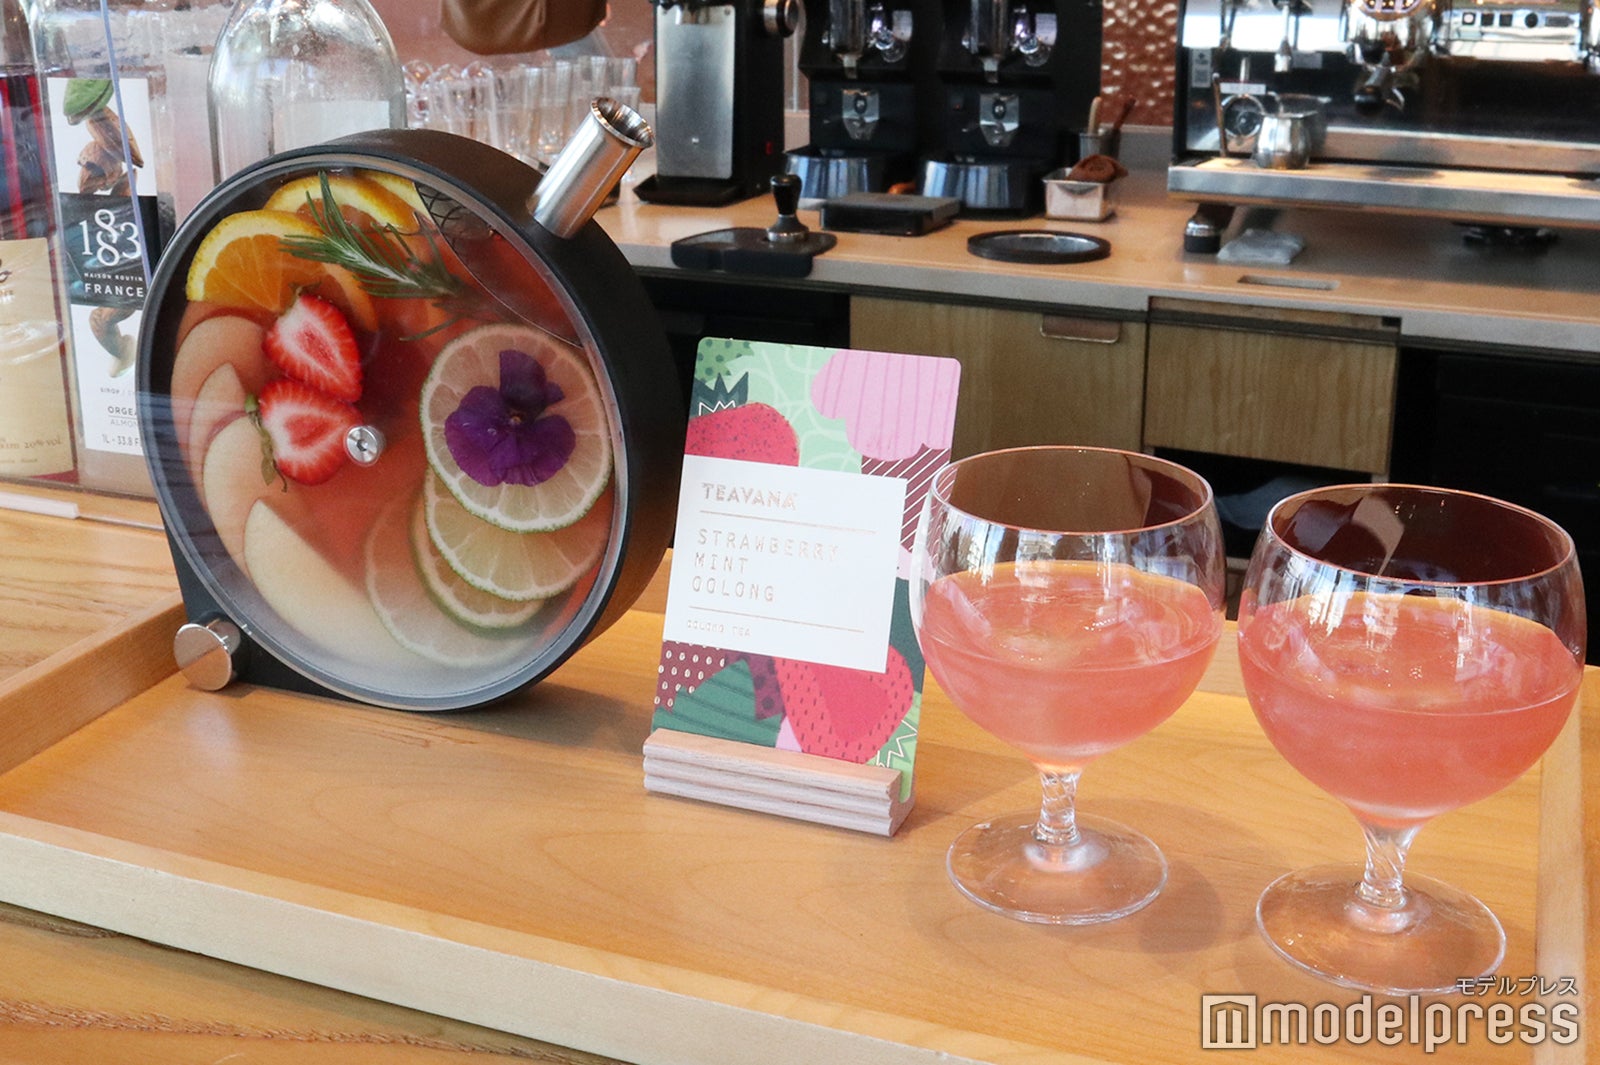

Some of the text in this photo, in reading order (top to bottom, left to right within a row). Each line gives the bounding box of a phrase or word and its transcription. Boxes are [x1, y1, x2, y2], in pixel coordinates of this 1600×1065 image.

[84, 283, 144, 297] FRANCE
[702, 482, 797, 510] TEAVANA
[697, 528, 840, 562] STRAWBERRY
[694, 551, 749, 574] MINT
[691, 575, 776, 602] OOLONG
[732, 625, 751, 637] TEA
